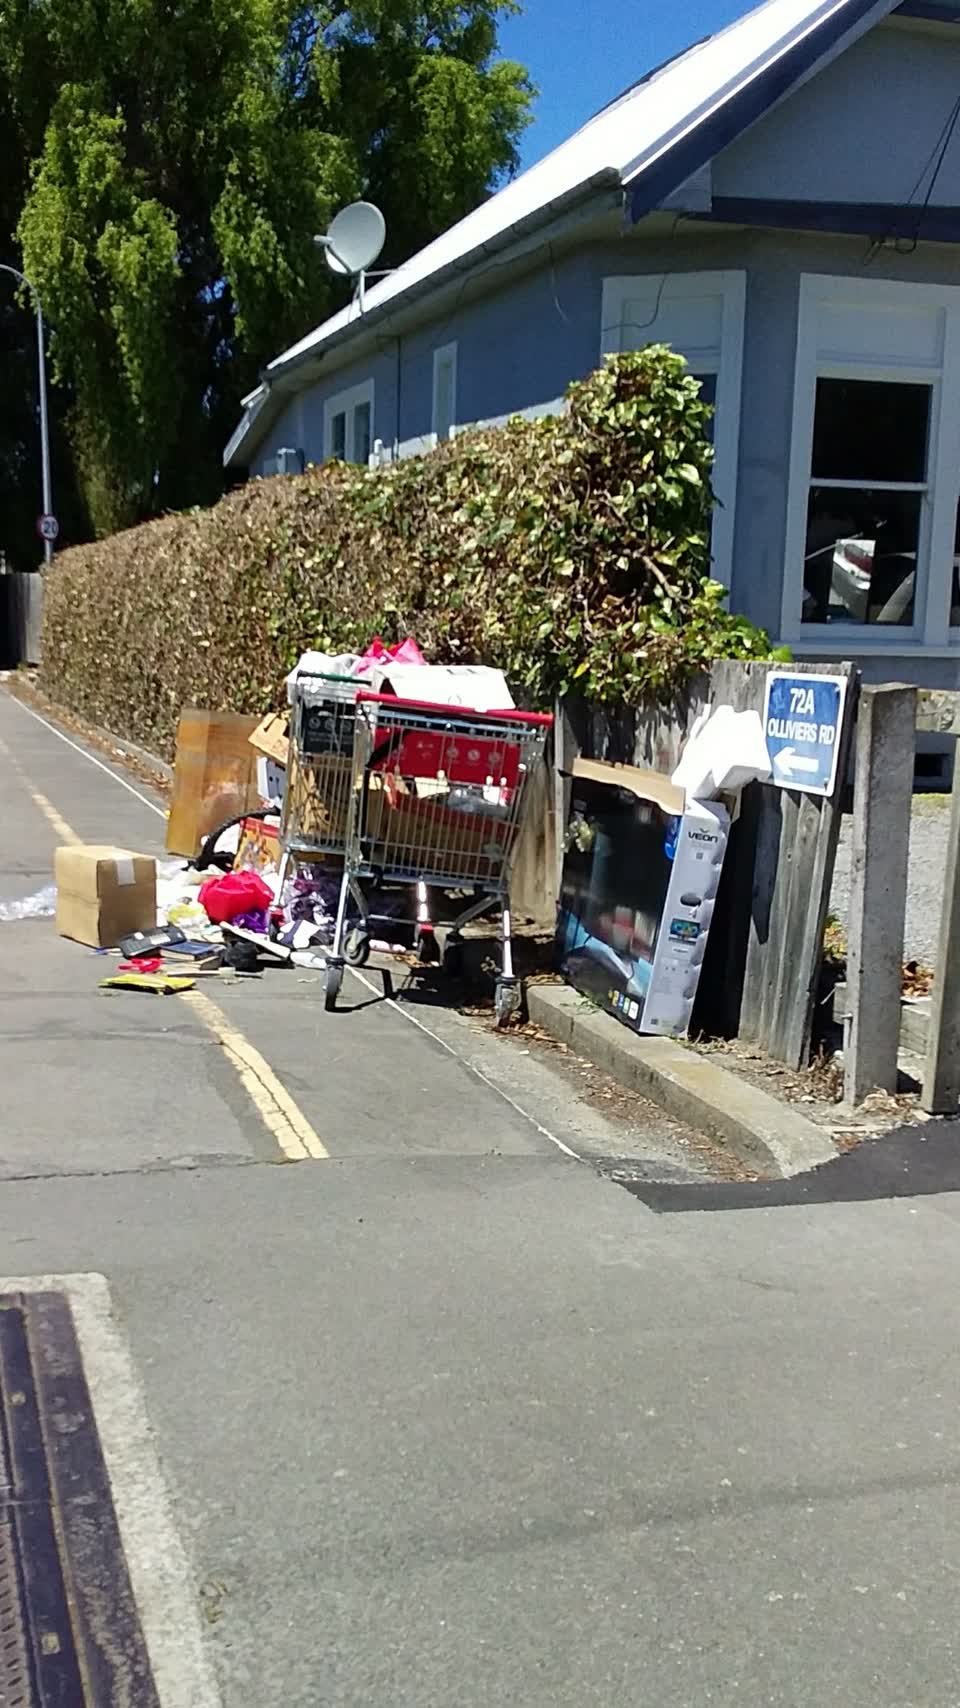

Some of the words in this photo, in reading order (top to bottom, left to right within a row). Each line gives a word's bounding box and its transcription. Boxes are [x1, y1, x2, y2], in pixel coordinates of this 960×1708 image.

[789, 687, 815, 715] 72A
[767, 717, 818, 743] OLLIVIERS
[818, 724, 835, 745] RD
